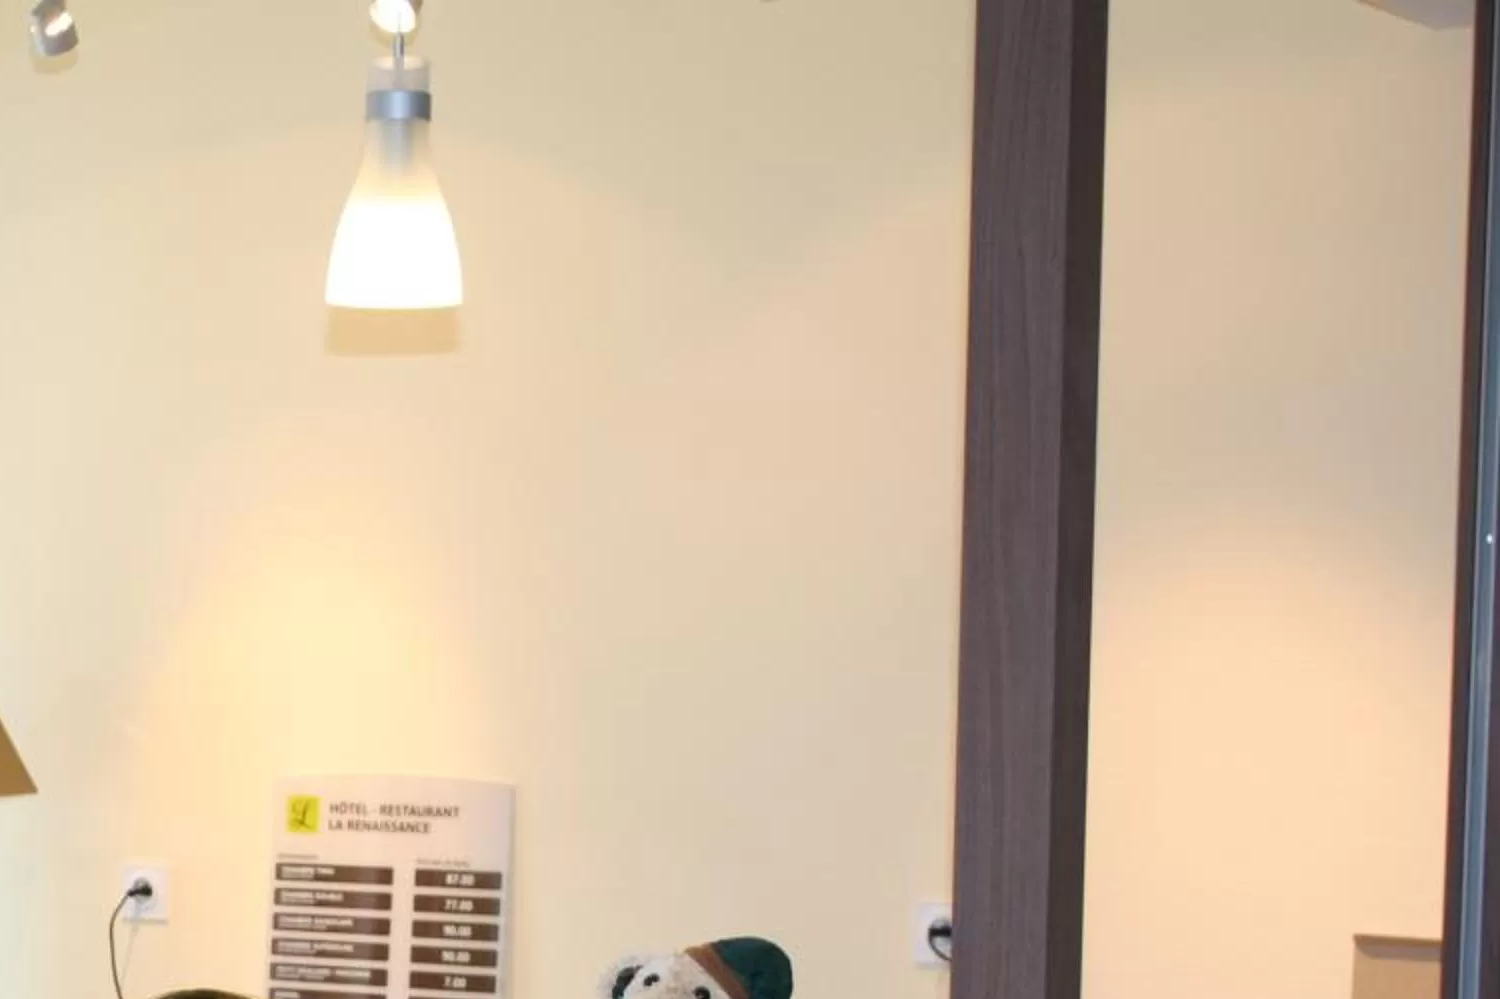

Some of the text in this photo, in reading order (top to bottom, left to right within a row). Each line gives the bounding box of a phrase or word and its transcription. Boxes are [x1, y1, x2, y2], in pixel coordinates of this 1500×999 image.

[329, 802, 368, 816] HÔTEL
[379, 804, 460, 818] RESTAURANT
[328, 819, 431, 834] LA RENAISSANCE
